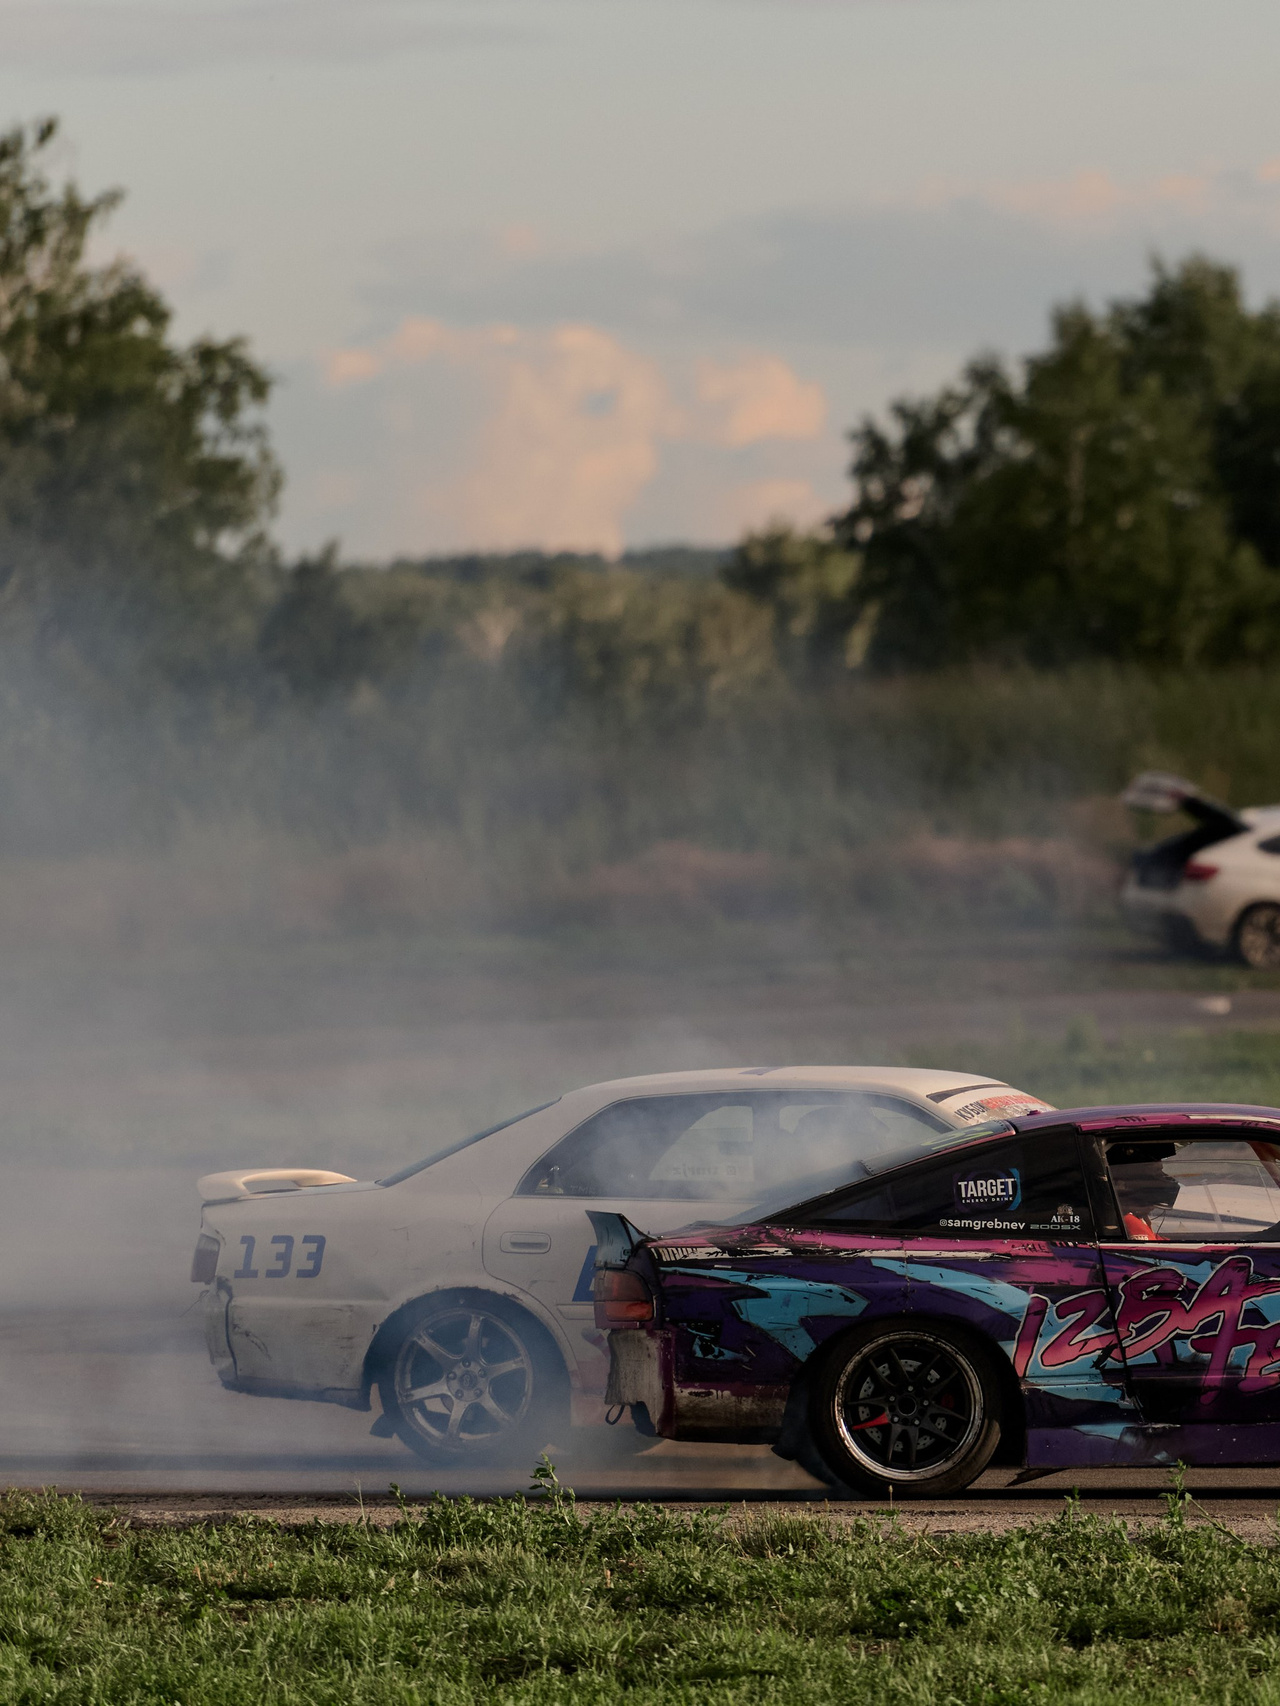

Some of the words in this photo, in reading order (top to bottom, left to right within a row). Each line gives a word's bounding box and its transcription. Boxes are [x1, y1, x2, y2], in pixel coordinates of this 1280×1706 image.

[958, 1178, 1016, 1198] TARGET
[1050, 1215, 1080, 1223] AK-18
[233, 1234, 327, 1279] 133
